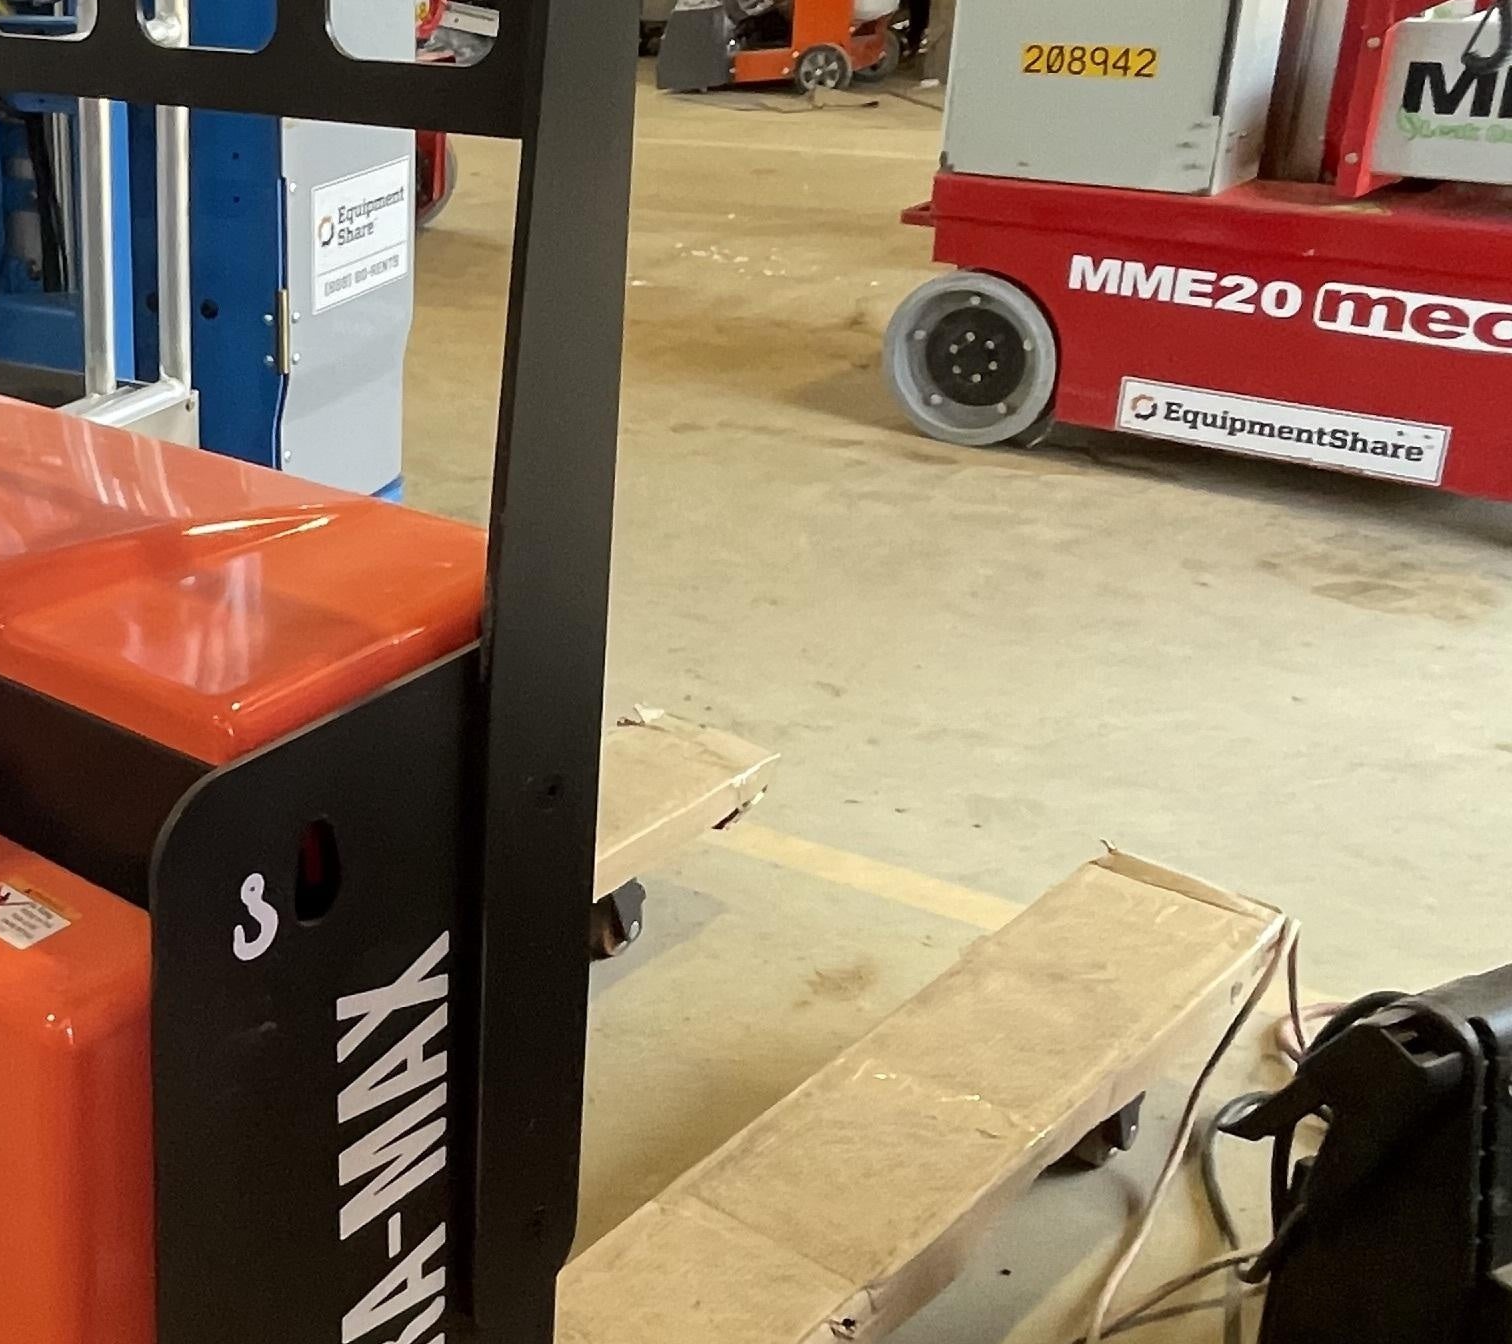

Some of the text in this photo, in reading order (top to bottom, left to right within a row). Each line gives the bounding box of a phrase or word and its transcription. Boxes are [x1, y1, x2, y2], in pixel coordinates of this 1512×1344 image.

[1023, 44, 1157, 78] 208942
[338, 186, 404, 224] Equipment
[338, 220, 375, 246] Share
[1068, 255, 1302, 318] MME20
[1164, 401, 1424, 462] EquipmentShare
